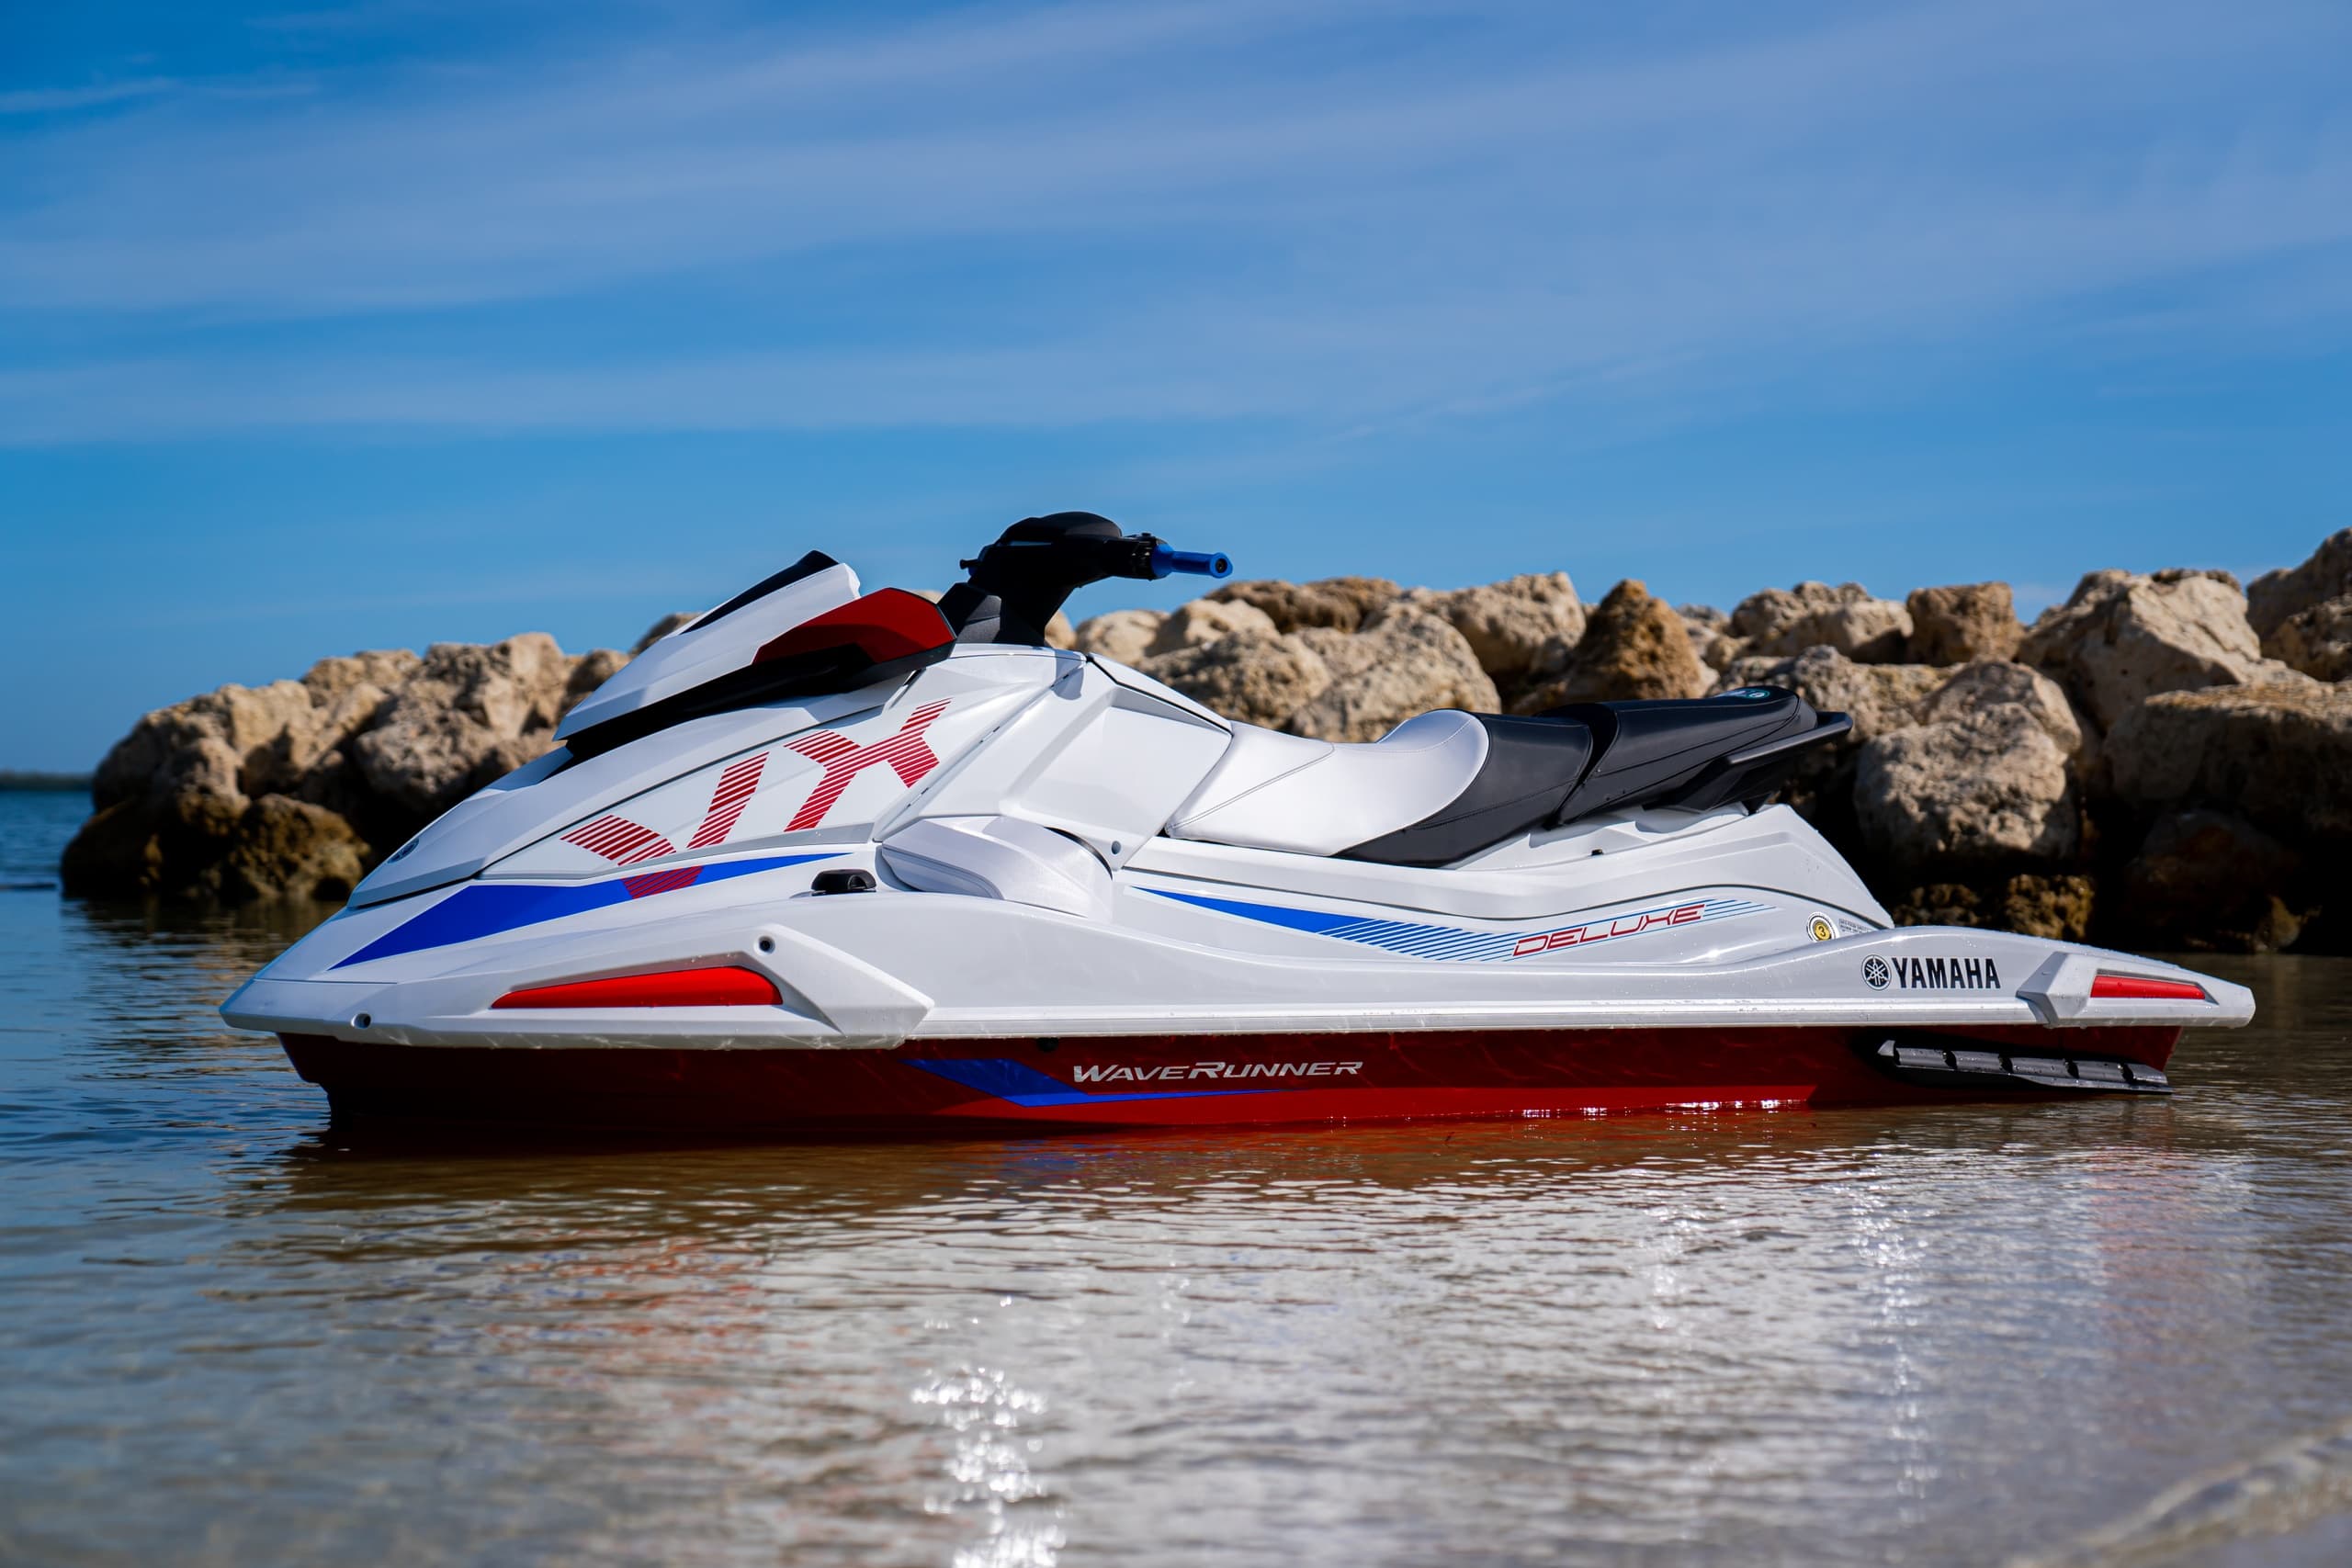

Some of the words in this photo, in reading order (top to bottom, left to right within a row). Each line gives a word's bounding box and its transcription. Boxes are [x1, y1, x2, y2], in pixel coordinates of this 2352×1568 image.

[560, 697, 953, 866] VX
[1512, 904, 1705, 957] DELUXE
[1817, 925, 1826, 937] 3
[1891, 957, 2001, 989] YAMAHA
